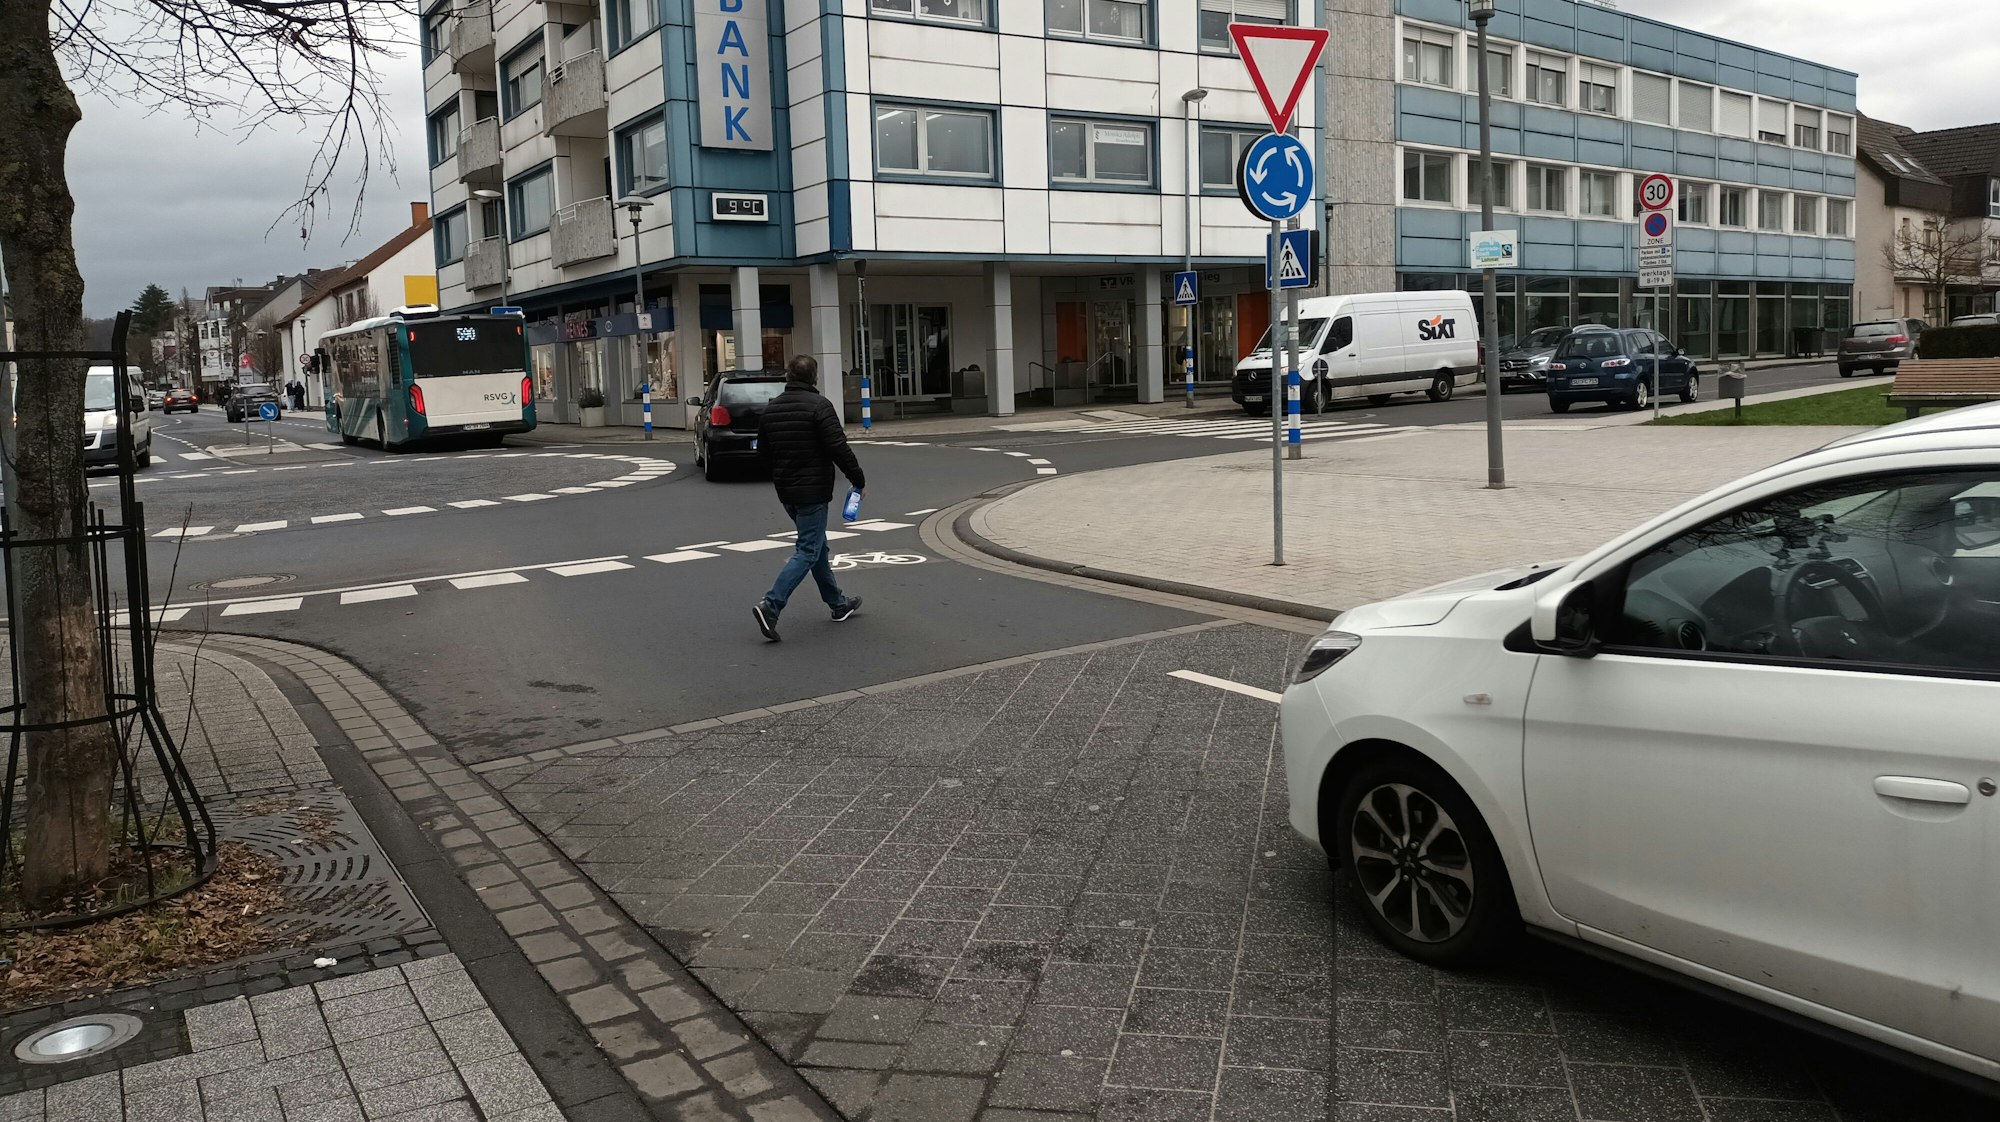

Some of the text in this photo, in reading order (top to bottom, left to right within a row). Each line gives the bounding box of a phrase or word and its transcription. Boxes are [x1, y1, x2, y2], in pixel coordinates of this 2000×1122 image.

[1647, 184, 1665, 200] 30
[729, 200, 738, 214] 9
[1641, 270, 1670, 278] werktags
[456, 327, 476, 341] 590
[484, 392, 508, 401] RSVG
